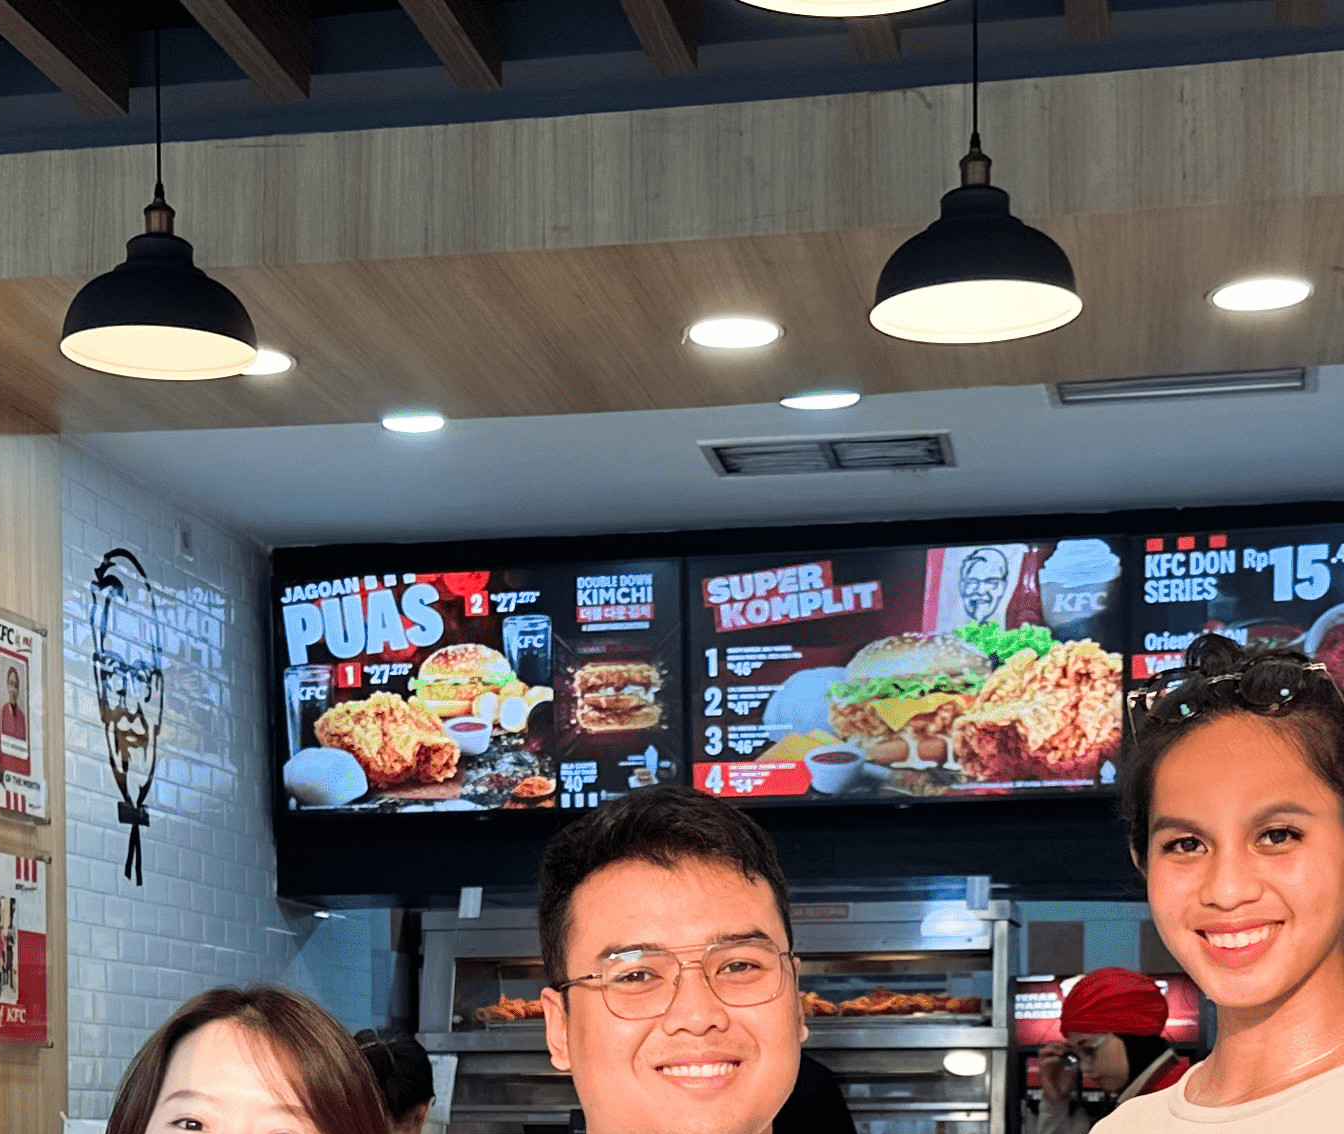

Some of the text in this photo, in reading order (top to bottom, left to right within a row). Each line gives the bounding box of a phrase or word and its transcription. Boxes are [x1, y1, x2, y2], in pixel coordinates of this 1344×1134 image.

[1144, 549, 1236, 578] KFC DON
[280, 576, 360, 603] JAGOAN
[577, 574, 653, 589] DOUBLE DOWN
[707, 563, 824, 604] SUPER
[1144, 577, 1218, 603] SERIES
[471, 594, 483, 614] 2
[577, 586, 653, 606] KIMCHI
[720, 582, 878, 628] KOMPLIT
[1052, 592, 1107, 612] KFC
[283, 583, 444, 666] PUAS
[515, 634, 545, 649] KFC
[345, 665, 354, 685] 1
[705, 648, 718, 677] 1
[298, 685, 328, 700] KFC
[704, 686, 723, 716] 2
[704, 725, 723, 755] 3
[705, 765, 724, 793] 4
[6, 1007, 26, 1023] KFC
